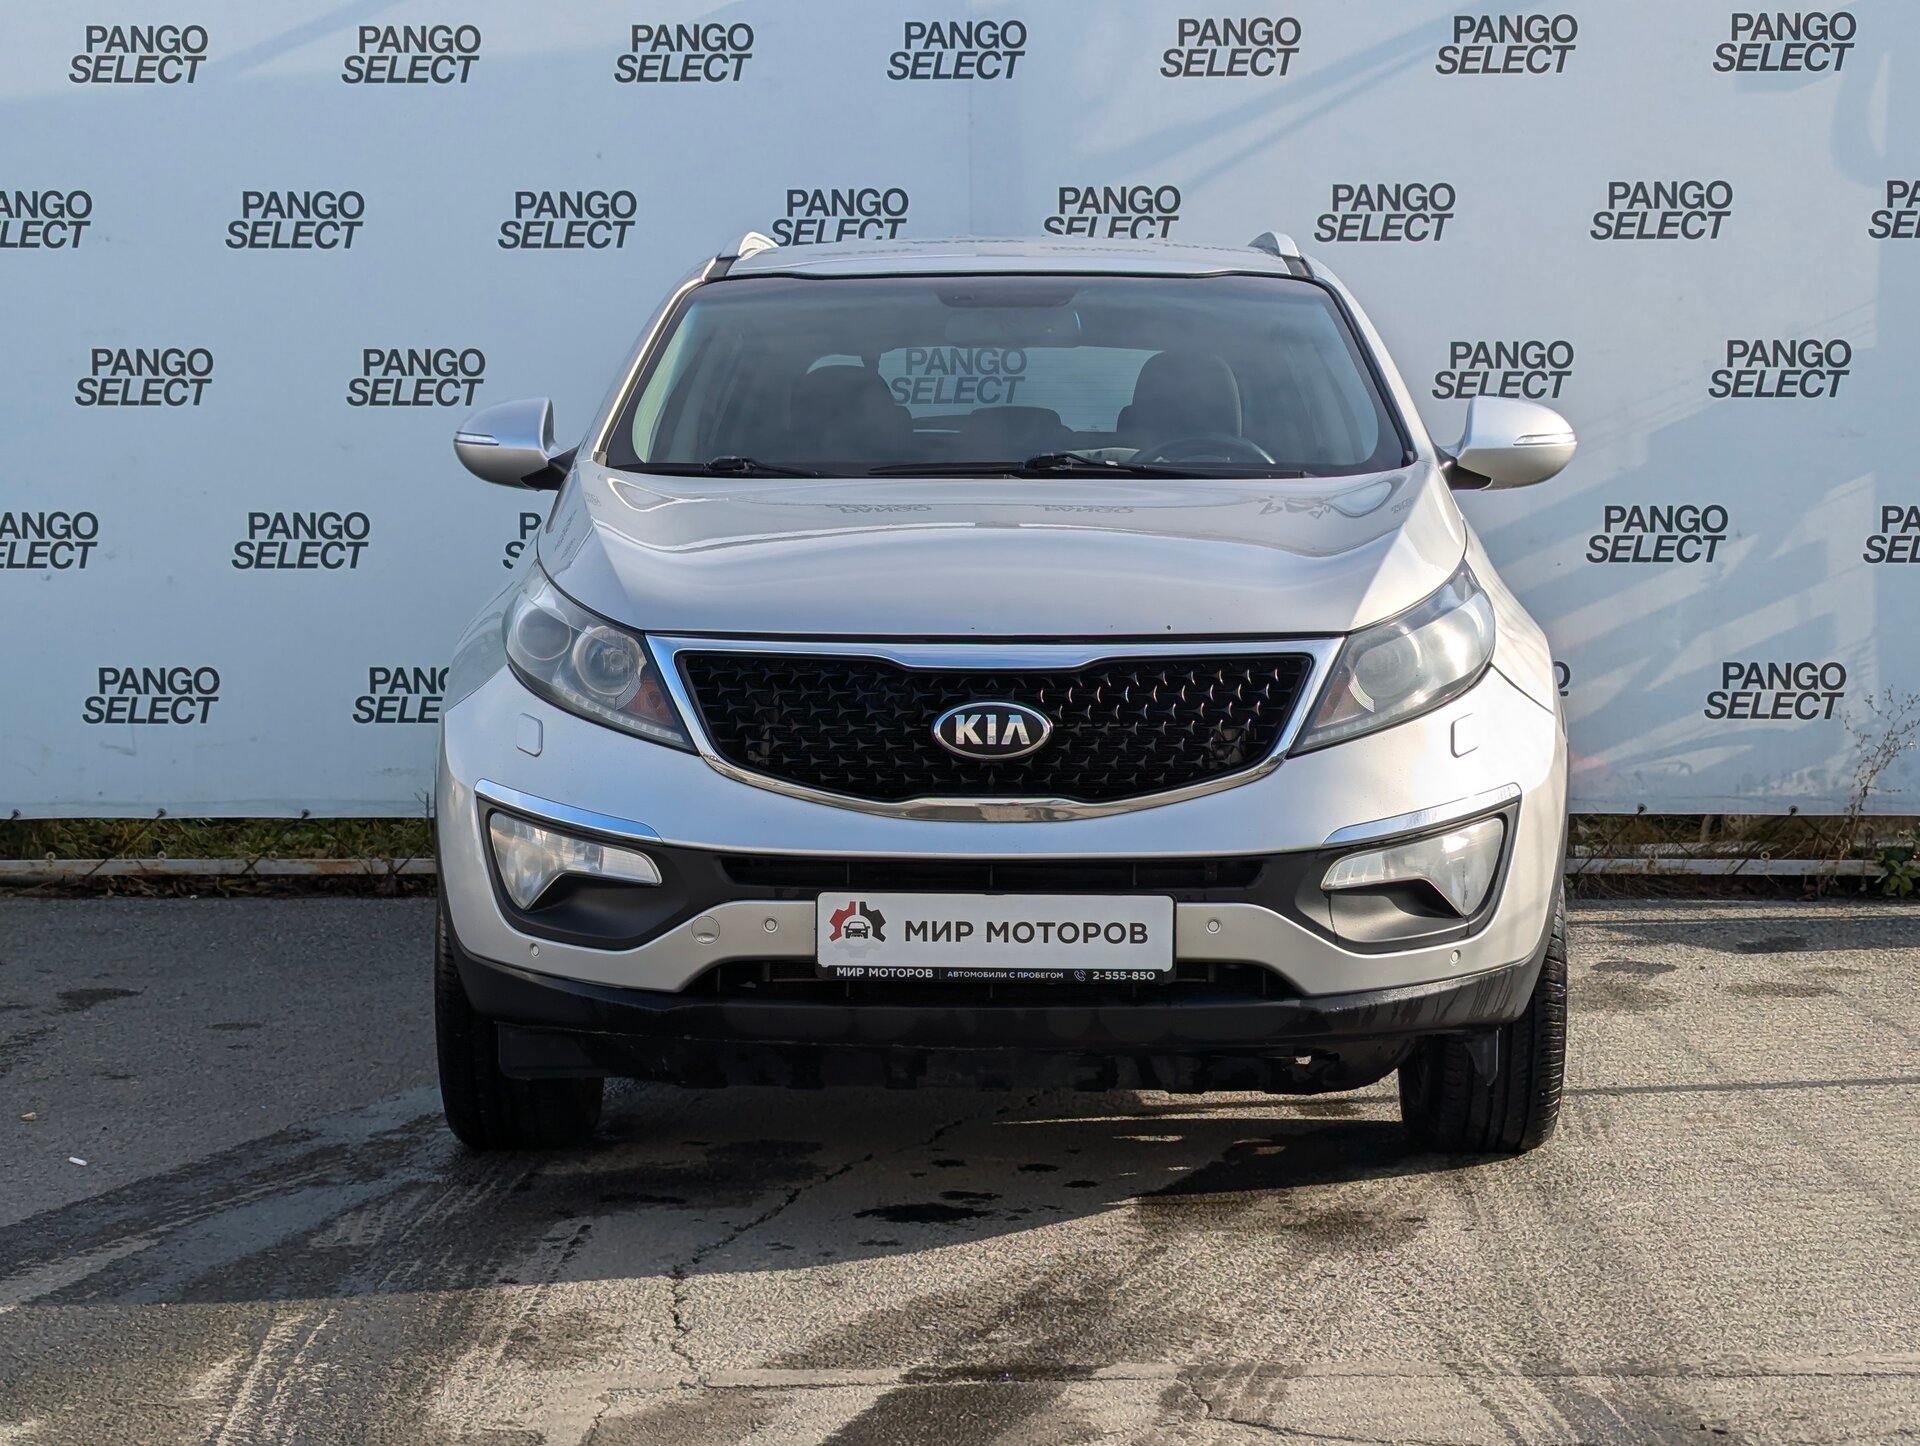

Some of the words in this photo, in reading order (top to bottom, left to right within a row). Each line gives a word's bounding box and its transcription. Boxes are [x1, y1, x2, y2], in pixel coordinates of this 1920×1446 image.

[86, 24, 209, 54] PANGO
[358, 24, 482, 54] PANGO
[631, 22, 754, 53] PANGO
[904, 19, 1027, 50] PANGO
[1178, 17, 1302, 47] PANGO
[1453, 14, 1578, 44] PANGO
[1731, 11, 1857, 42] PANGO
[68, 54, 207, 84] SELECT
[341, 54, 480, 84] SELECT
[613, 52, 753, 84] SELECT
[886, 50, 1026, 81] SELECT
[1159, 47, 1300, 78] SELECT
[1435, 44, 1577, 75] SELECT
[1712, 42, 1855, 73] SELECT
[242, 190, 365, 220] PANGO
[514, 189, 638, 220] PANGO
[786, 187, 909, 218] PANGO
[1058, 185, 1181, 216] PANGO
[1332, 182, 1456, 213] PANGO
[1608, 180, 1733, 211] PANGO
[0, 219, 92, 249] LECT
[225, 219, 364, 250] SELECT
[497, 219, 636, 250] SELECT
[769, 217, 908, 247] SELECT
[1042, 215, 1180, 240] SELECT
[1313, 212, 1454, 243] SELECT
[1590, 210, 1732, 241] SELECT
[91, 347, 214, 377] PANGO
[363, 347, 486, 378] PANGO
[905, 347, 1028, 376] PANGO
[1450, 340, 1574, 371] PANGO
[1726, 338, 1852, 369] PANGO
[74, 377, 213, 407] SELECT
[346, 377, 485, 407] SELECT
[890, 375, 1026, 405] SELECT
[1431, 370, 1573, 400] SELECT
[1708, 368, 1851, 399] SELECT
[248, 511, 371, 541] PANGO
[1604, 504, 1729, 535] PANGO
[231, 540, 370, 570] SELECT
[1585, 534, 1727, 564] SELECT
[98, 666, 221, 696] PANGO
[1722, 660, 1847, 691] PANGO
[81, 695, 220, 725] SELECT
[1703, 690, 1845, 721] SELECT
[955, 714, 1031, 745] KIA
[904, 920, 974, 943] МИР
[986, 920, 1149, 944] МОТОРОВ
[836, 966, 865, 977] МИР
[868, 967, 934, 978] МОТОРОВ
[947, 970, 1007, 979] АВТОМОБИЛИ
[1017, 971, 1064, 979] ПРОБЕГОМ
[1092, 971, 1156, 980] 2-555-850
